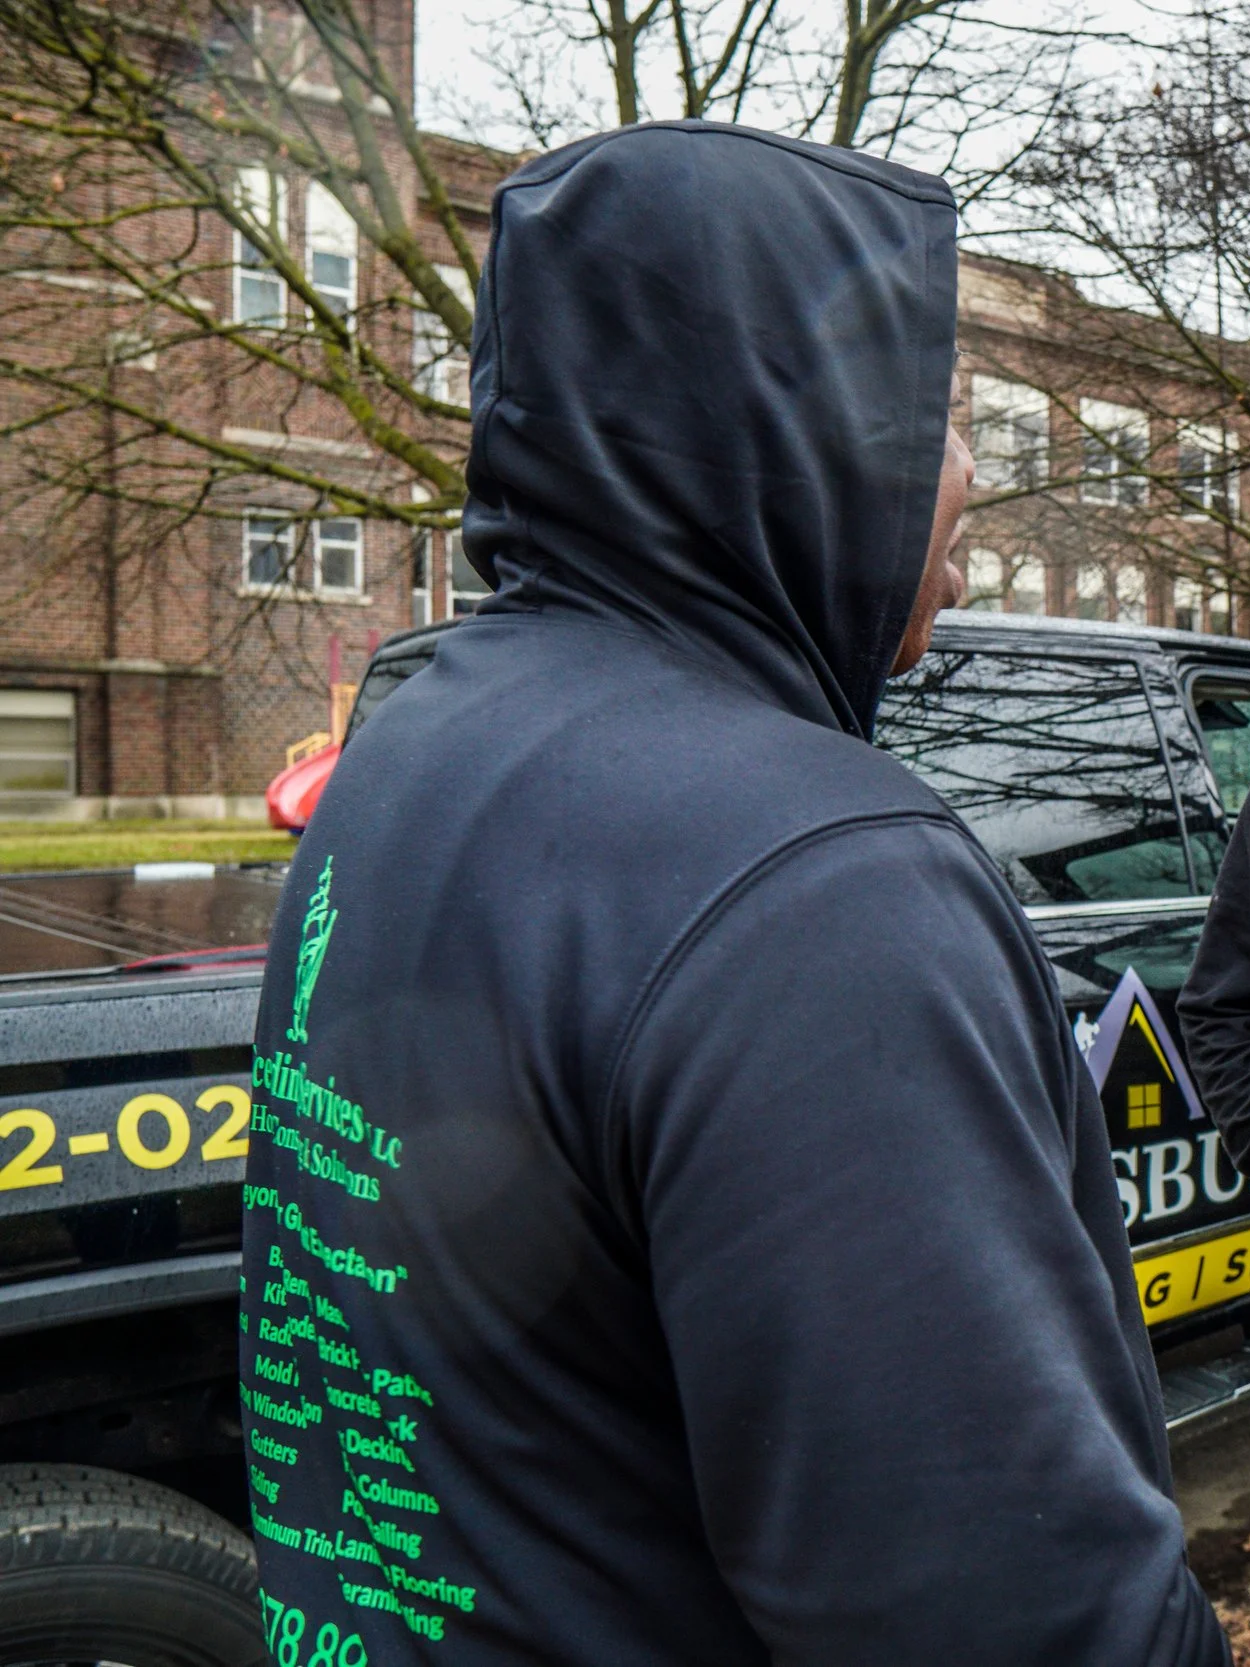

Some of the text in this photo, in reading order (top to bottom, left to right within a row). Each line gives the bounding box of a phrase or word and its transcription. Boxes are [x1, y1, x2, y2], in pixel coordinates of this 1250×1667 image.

[1144, 1271, 1171, 1308] G
[255, 1354, 294, 1385] Mold
[251, 1428, 298, 1466] Gutters
[358, 1474, 440, 1514] Columns
